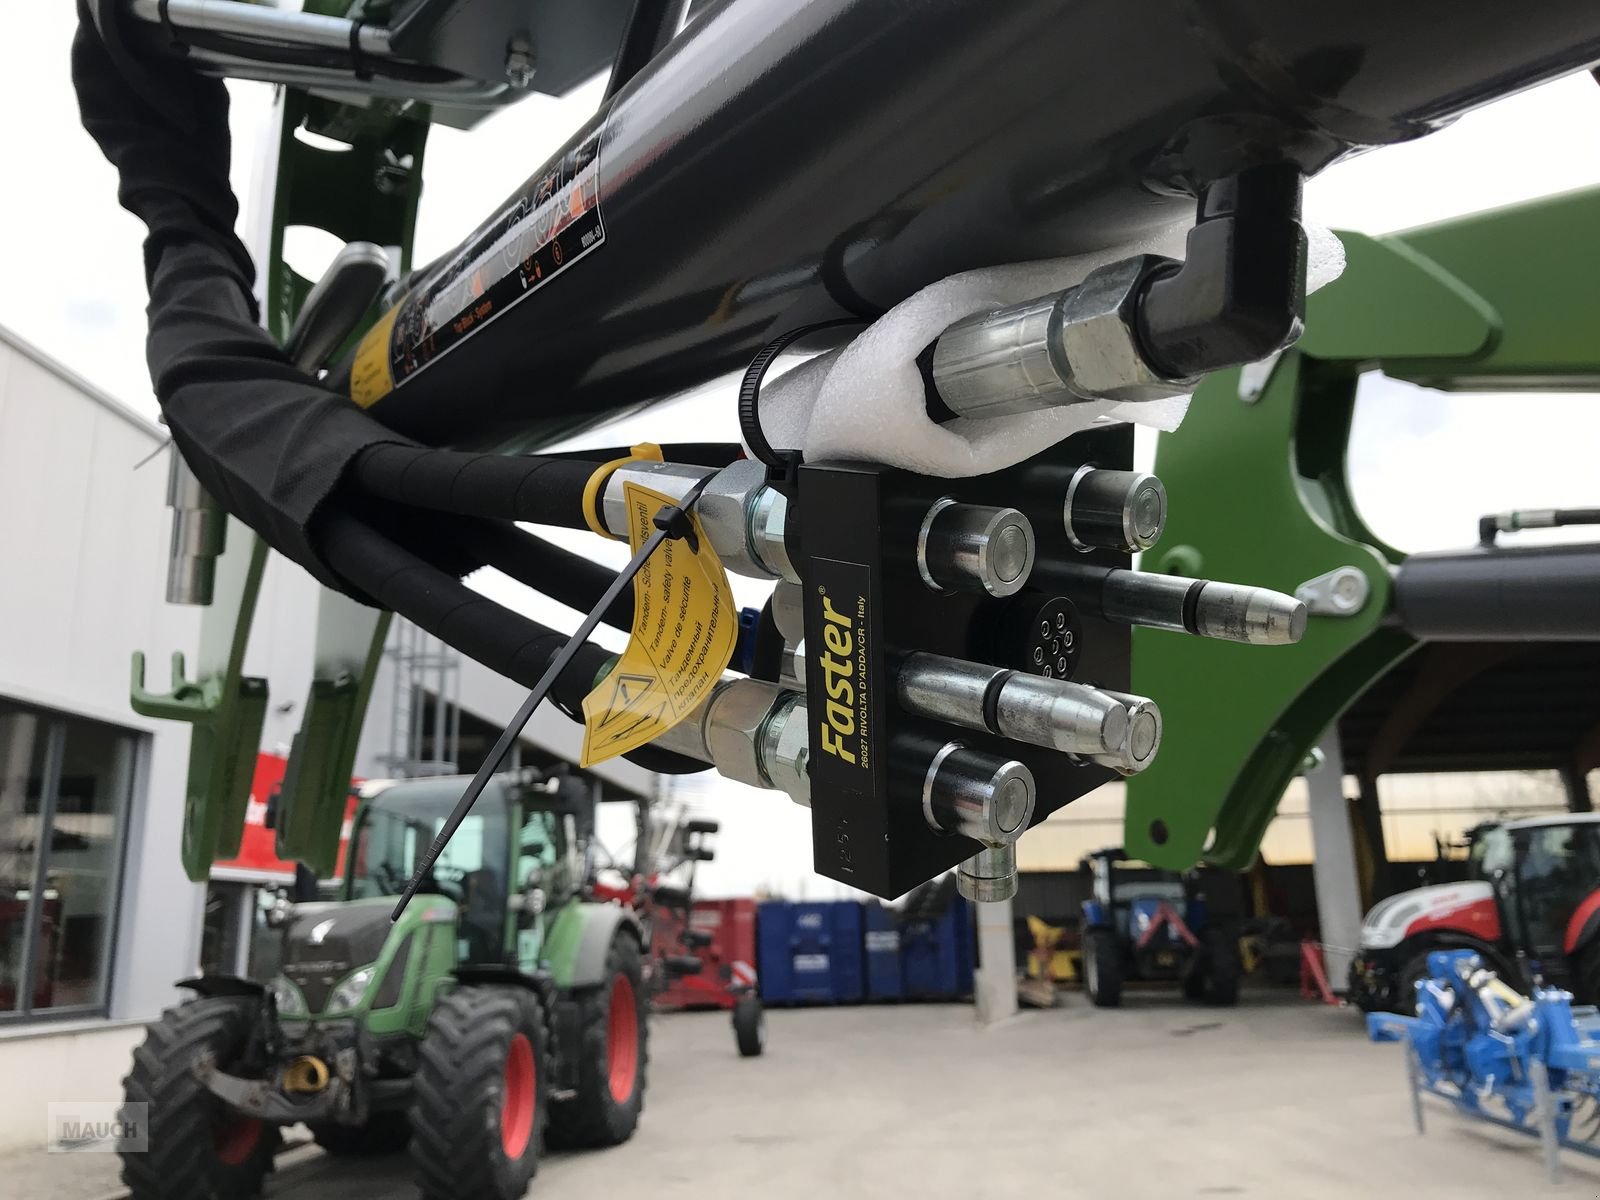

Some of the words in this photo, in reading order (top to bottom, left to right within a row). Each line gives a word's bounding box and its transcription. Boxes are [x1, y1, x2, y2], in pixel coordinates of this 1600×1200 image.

[663, 539, 674, 568] valve
[662, 569, 674, 604] safety
[857, 595, 866, 618] Italy
[649, 605, 669, 653] Tandem-
[660, 639, 676, 670] Valve
[674, 622, 683, 638] de
[669, 620, 703, 688] Тандемный
[678, 671, 710, 711] клапан
[859, 692, 869, 737] RIVOLTA
[860, 738, 869, 769] 26027
